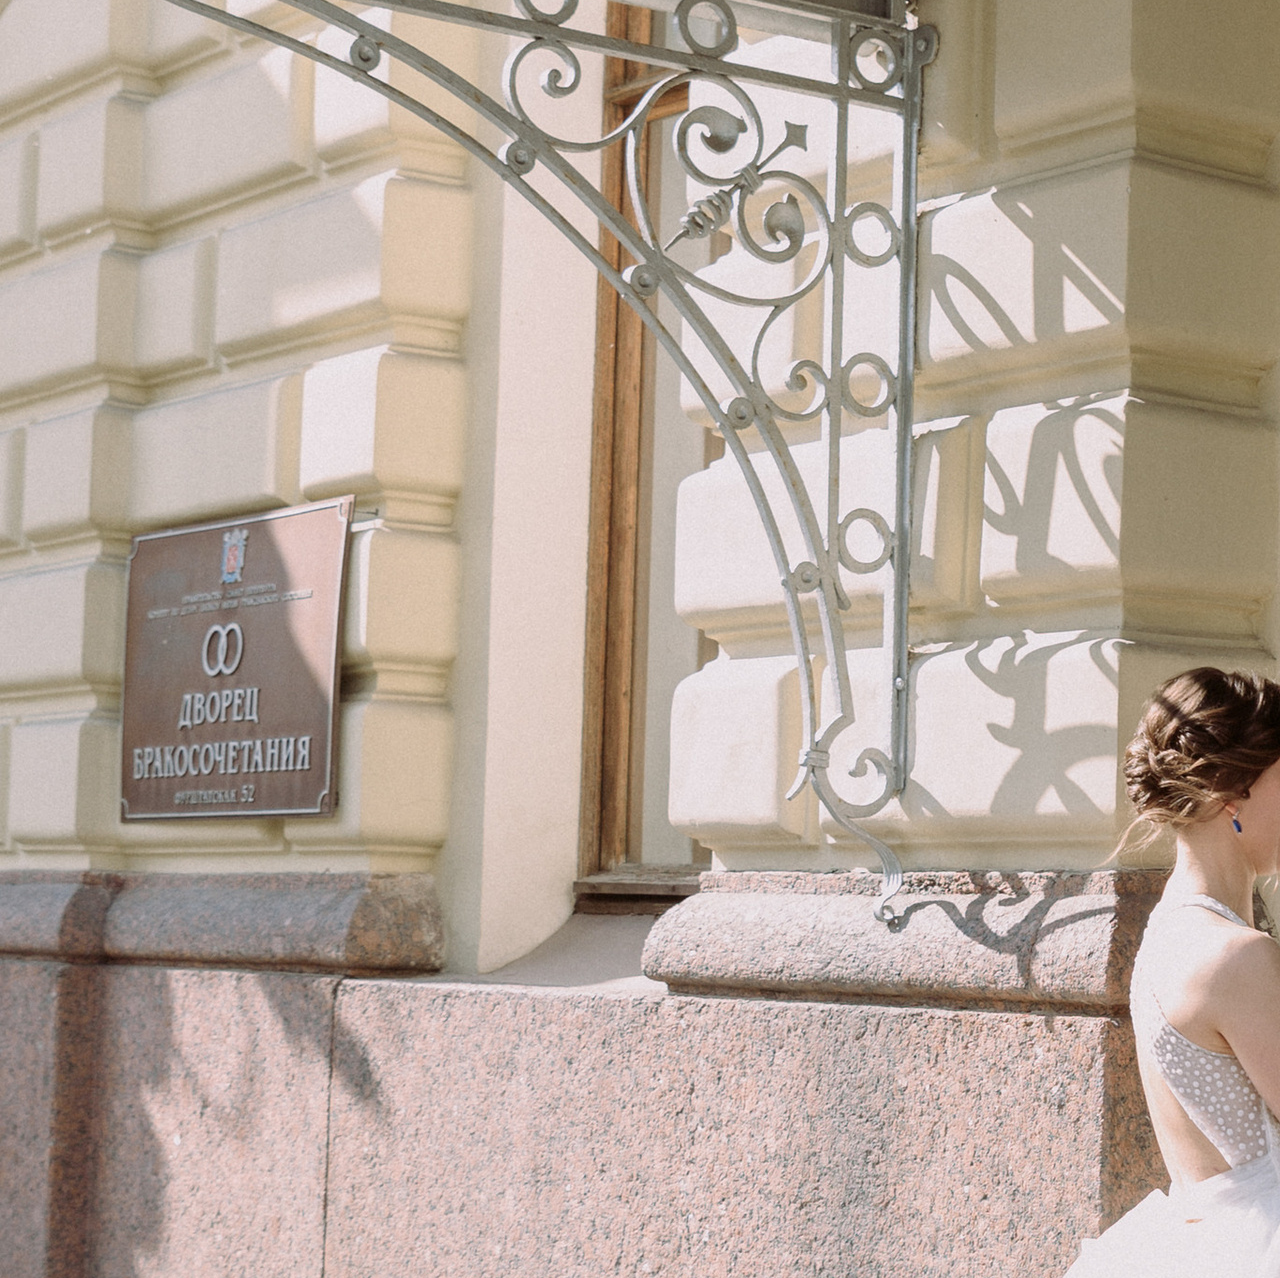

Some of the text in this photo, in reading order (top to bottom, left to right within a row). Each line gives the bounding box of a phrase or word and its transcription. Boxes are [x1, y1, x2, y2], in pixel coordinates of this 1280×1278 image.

[178, 688, 259, 730] ДВОРЕЦ
[132, 736, 312, 780] БРАКОСОЧЕТАНИЯ
[241, 784, 255, 803] 52
